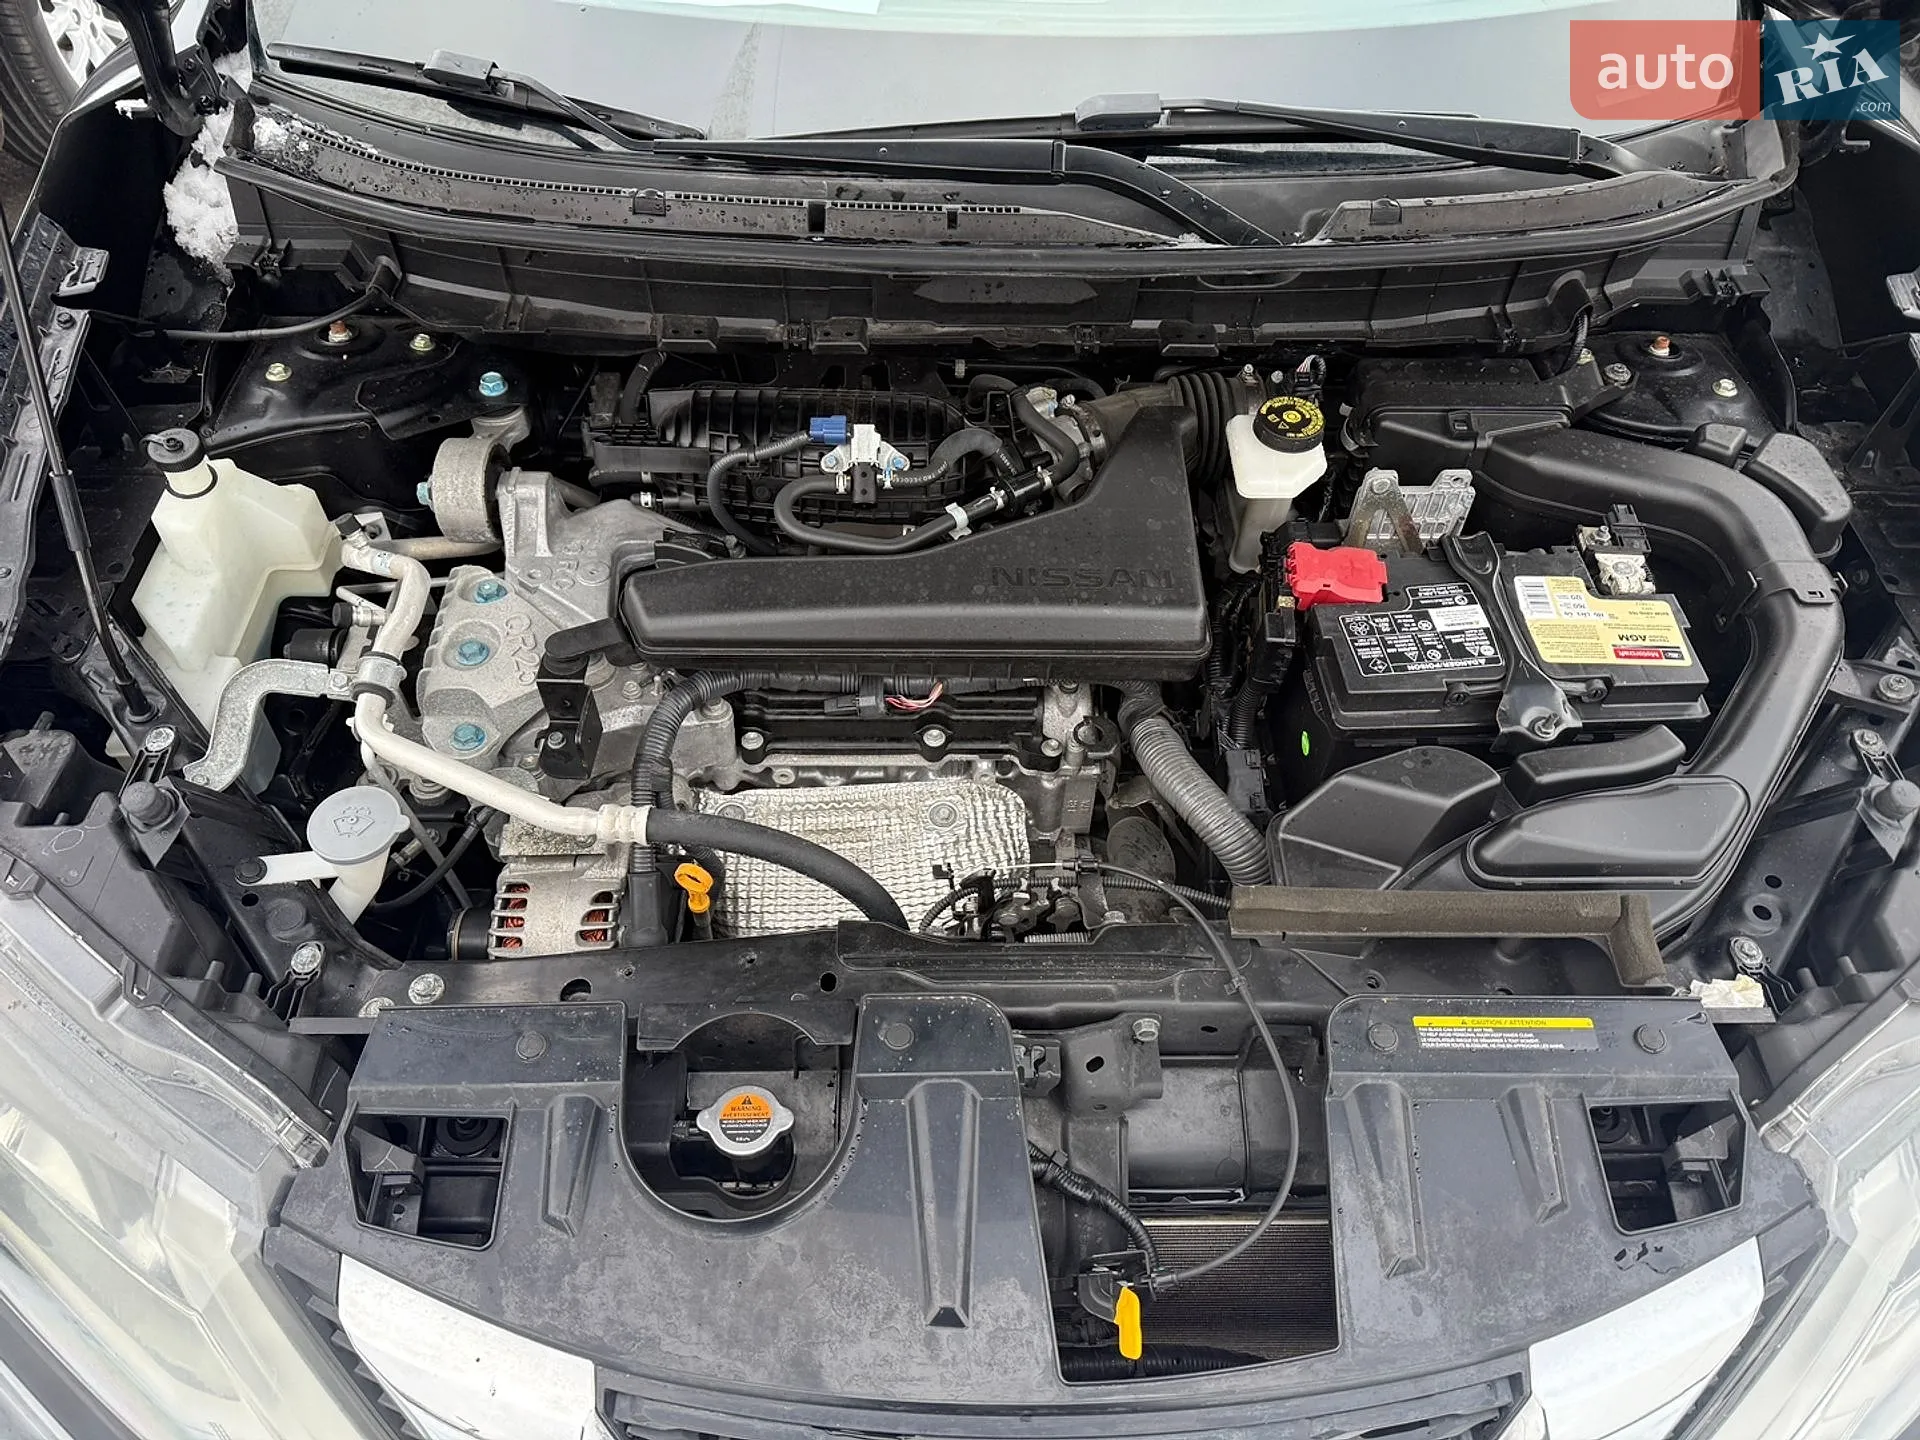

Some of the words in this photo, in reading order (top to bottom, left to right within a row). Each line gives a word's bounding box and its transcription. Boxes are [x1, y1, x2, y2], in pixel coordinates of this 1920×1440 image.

[992, 567, 1174, 589] NISSAN
[1618, 634, 1647, 642] AGM
[505, 612, 540, 686] QR25
[1617, 650, 1660, 658] Motorcraft
